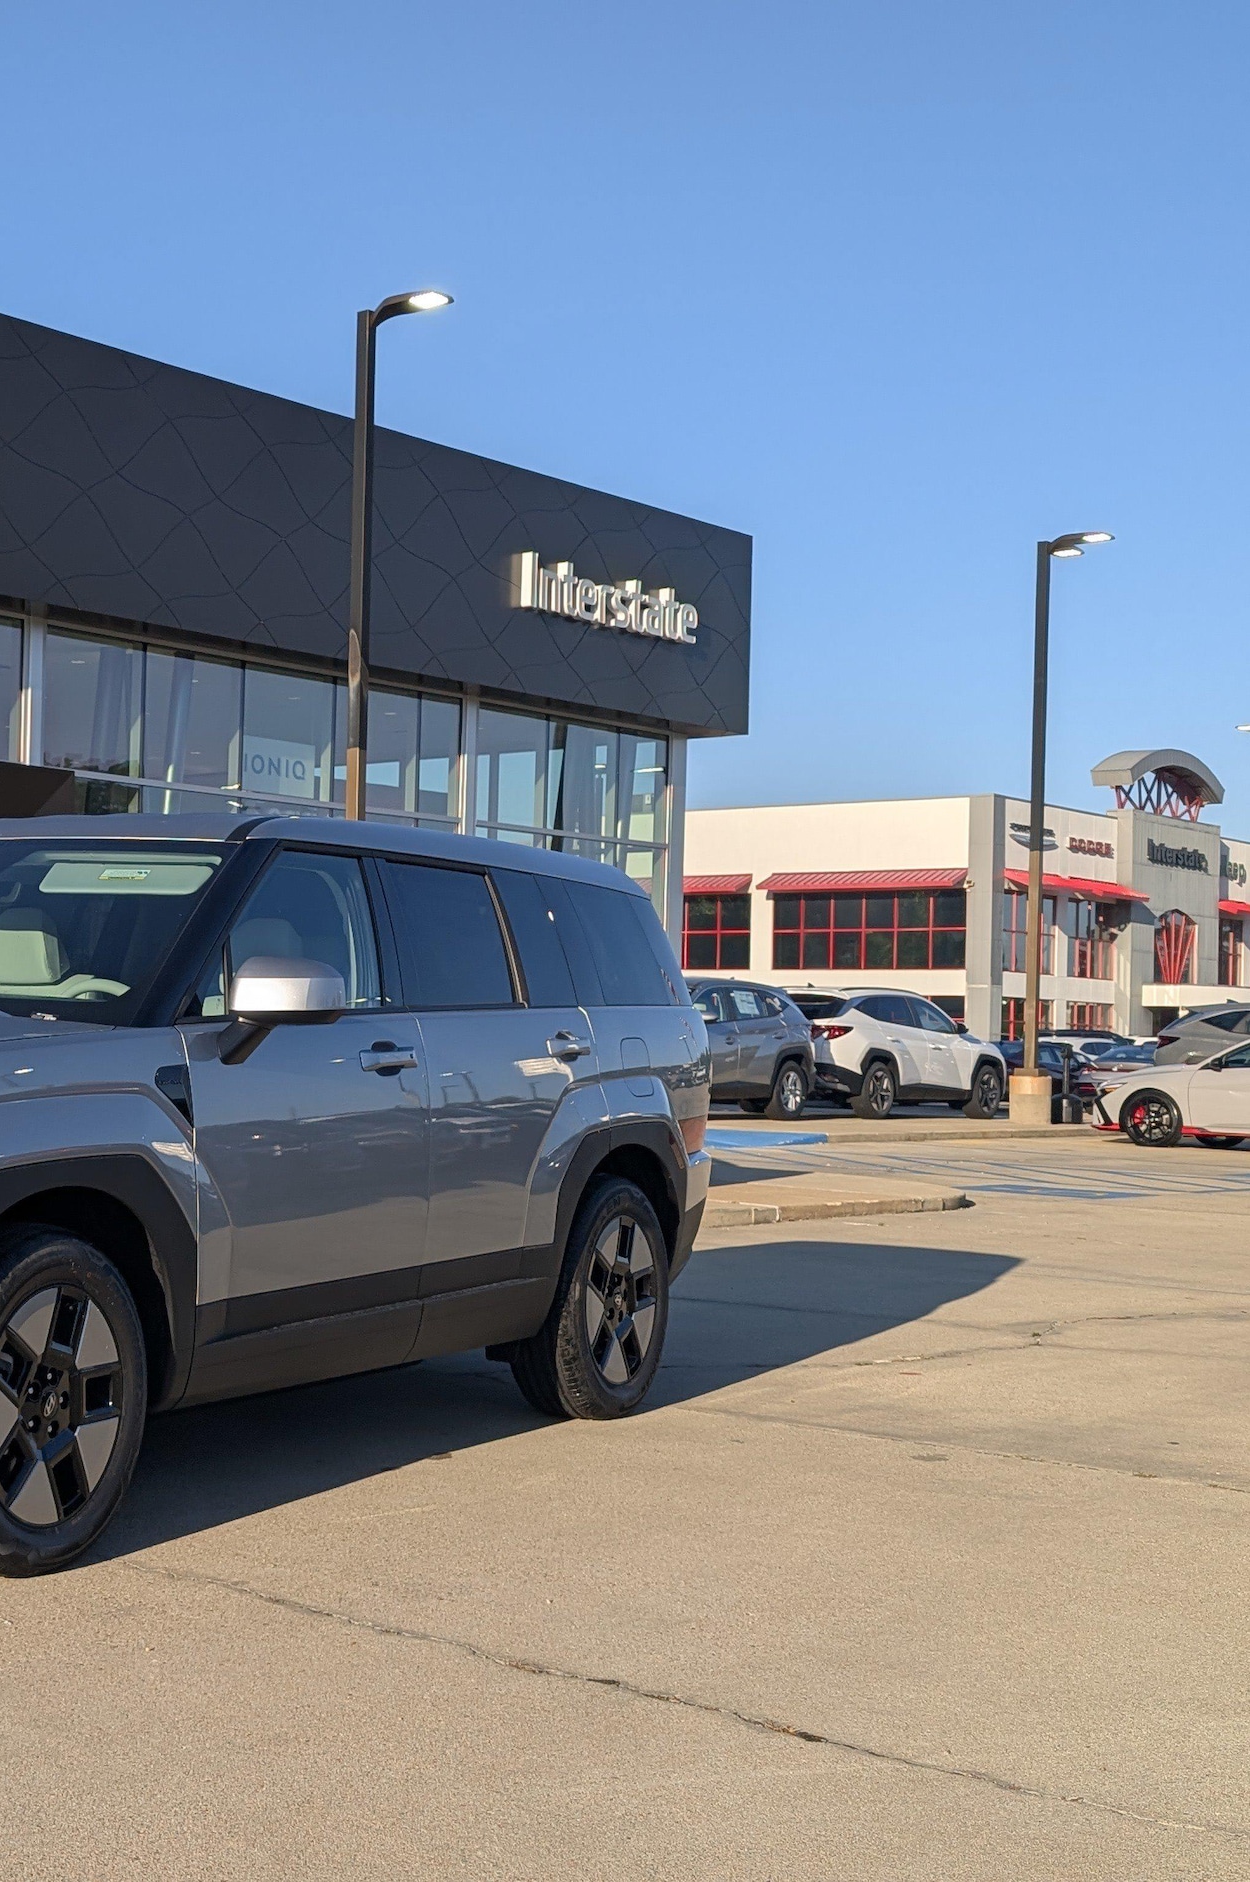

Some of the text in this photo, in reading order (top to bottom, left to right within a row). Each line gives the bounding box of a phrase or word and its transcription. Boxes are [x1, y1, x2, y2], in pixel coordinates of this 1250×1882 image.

[520, 551, 699, 645] Interstate
[244, 753, 306, 780] IONIQ
[1068, 836, 1112, 857] DODGE
[1147, 838, 1209, 874] Interstate
